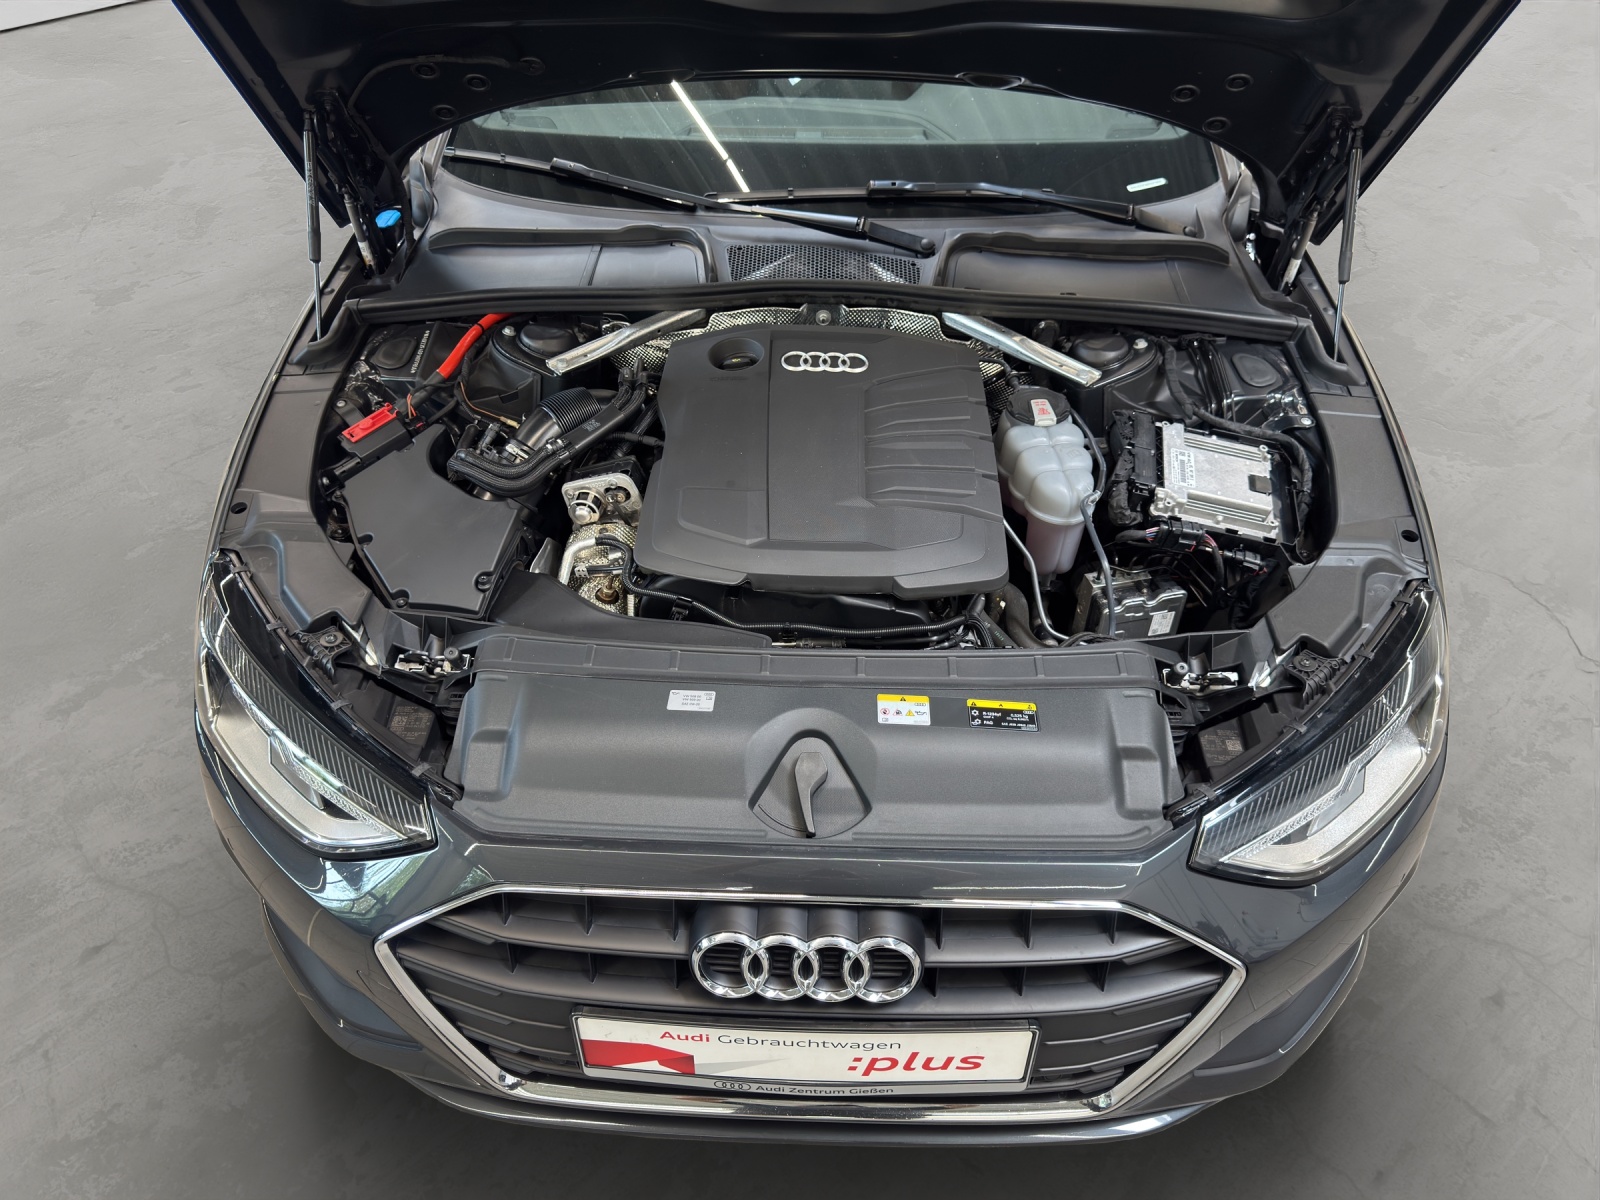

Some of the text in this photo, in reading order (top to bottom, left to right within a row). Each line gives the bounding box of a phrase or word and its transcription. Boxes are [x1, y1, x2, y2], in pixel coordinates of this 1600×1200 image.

[659, 1031, 902, 1052] Audi Gebrauchtwagen
[847, 1051, 985, 1077] :plus
[755, 1085, 894, 1095] Audi Zentrum Gießen
